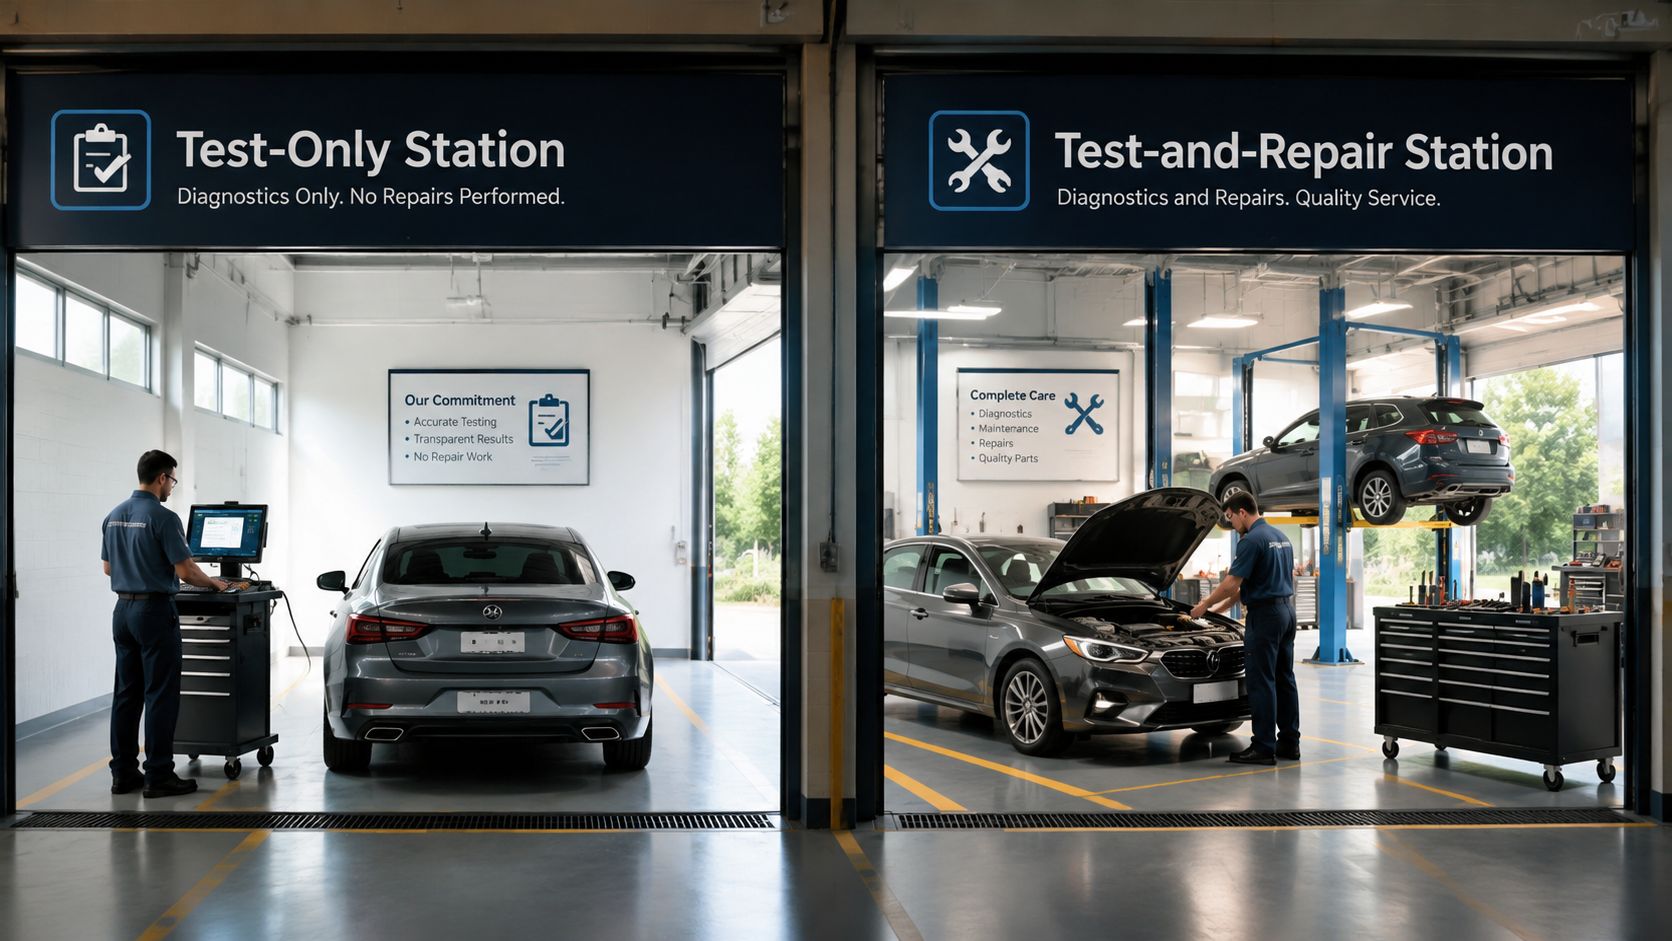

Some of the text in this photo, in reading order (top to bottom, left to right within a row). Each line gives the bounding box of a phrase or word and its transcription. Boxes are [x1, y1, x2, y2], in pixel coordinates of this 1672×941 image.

[176, 129, 564, 177] Test-Only Station
[1055, 131, 1552, 179] Test-and-Repair Station
[178, 187, 564, 209] Diagnostics Only. No Repairs Performed.
[1058, 188, 1440, 210] Diagnostics and Repairs. Quality Service.
[405, 394, 516, 406] Our Commitment
[971, 390, 1056, 402] Complete Care
[978, 408, 1033, 421] Diagnostics
[413, 416, 497, 430] Accurate Testing
[413, 433, 514, 447] Transparent Results
[979, 438, 1014, 450] Repairs
[413, 451, 493, 464] No Repair Work
[1014, 453, 1039, 464] Parts
